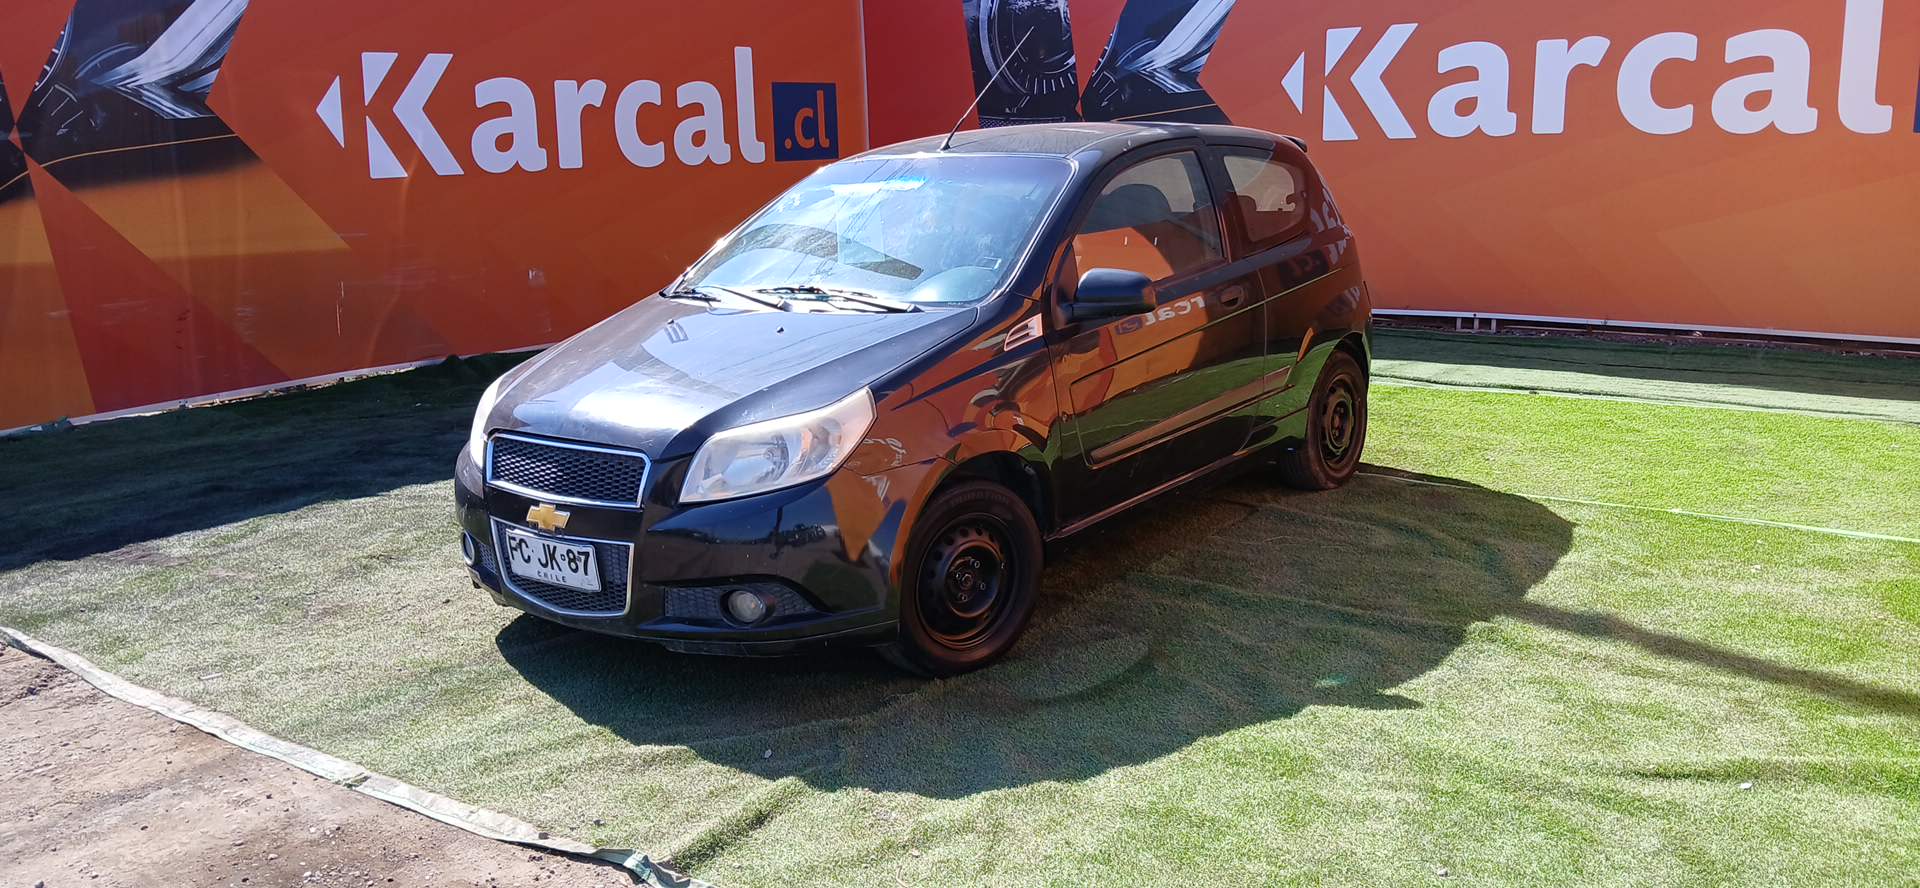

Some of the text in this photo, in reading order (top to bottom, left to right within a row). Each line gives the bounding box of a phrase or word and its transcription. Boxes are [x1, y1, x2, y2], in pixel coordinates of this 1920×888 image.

[315, 46, 766, 179] Karcal
[1280, 0, 1893, 141] Karcal
[537, 570, 567, 583] CHILE
